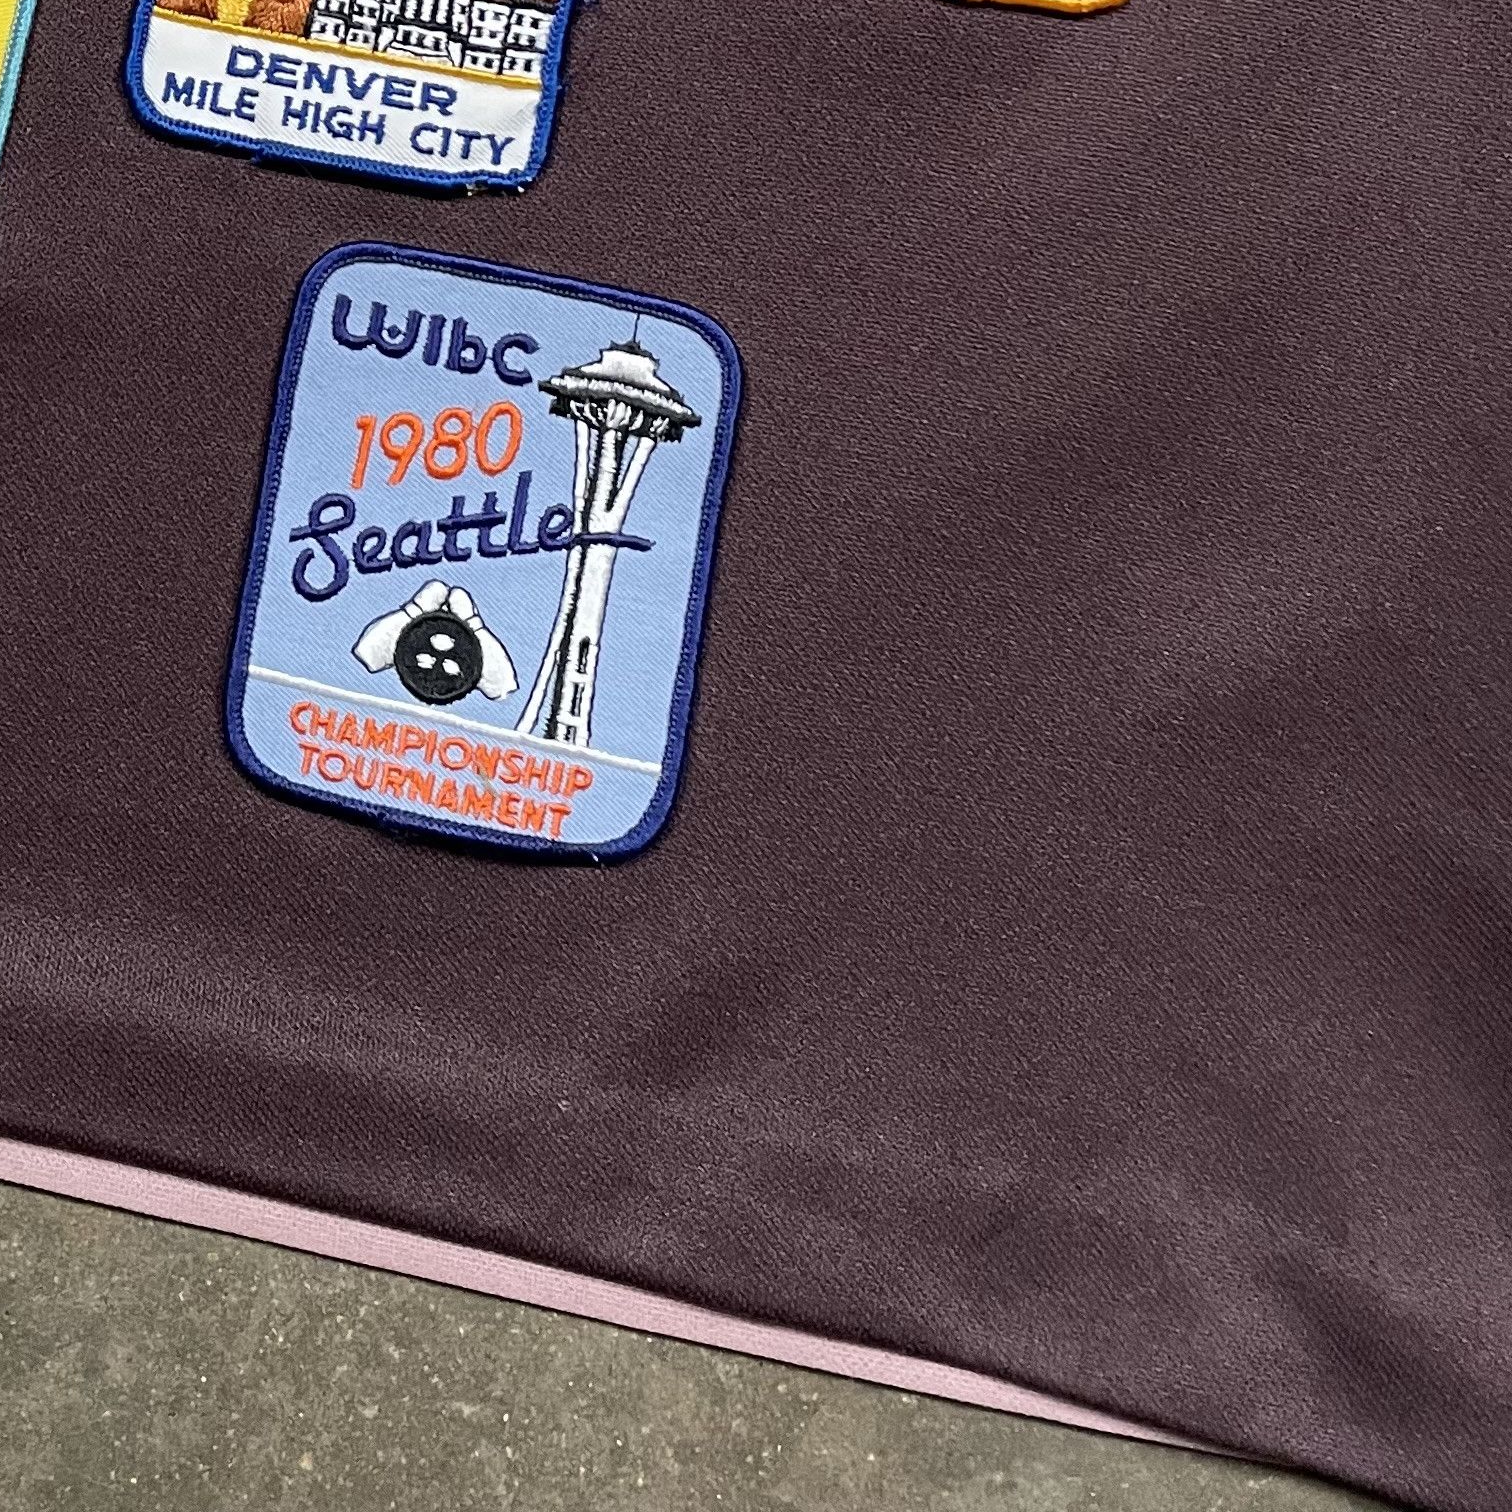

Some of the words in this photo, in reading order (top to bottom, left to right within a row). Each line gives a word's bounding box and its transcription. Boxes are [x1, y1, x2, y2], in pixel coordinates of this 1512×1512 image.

[161, 71, 257, 122] MILE
[281, 98, 387, 146] HIGH
[410, 123, 517, 168] CITY
[226, 45, 458, 116] DENVER
[348, 400, 523, 490] 1980
[288, 470, 656, 603] Seattle
[289, 700, 594, 792] CHAMPIONSHIP
[297, 742, 572, 841] TOURNAMENT
